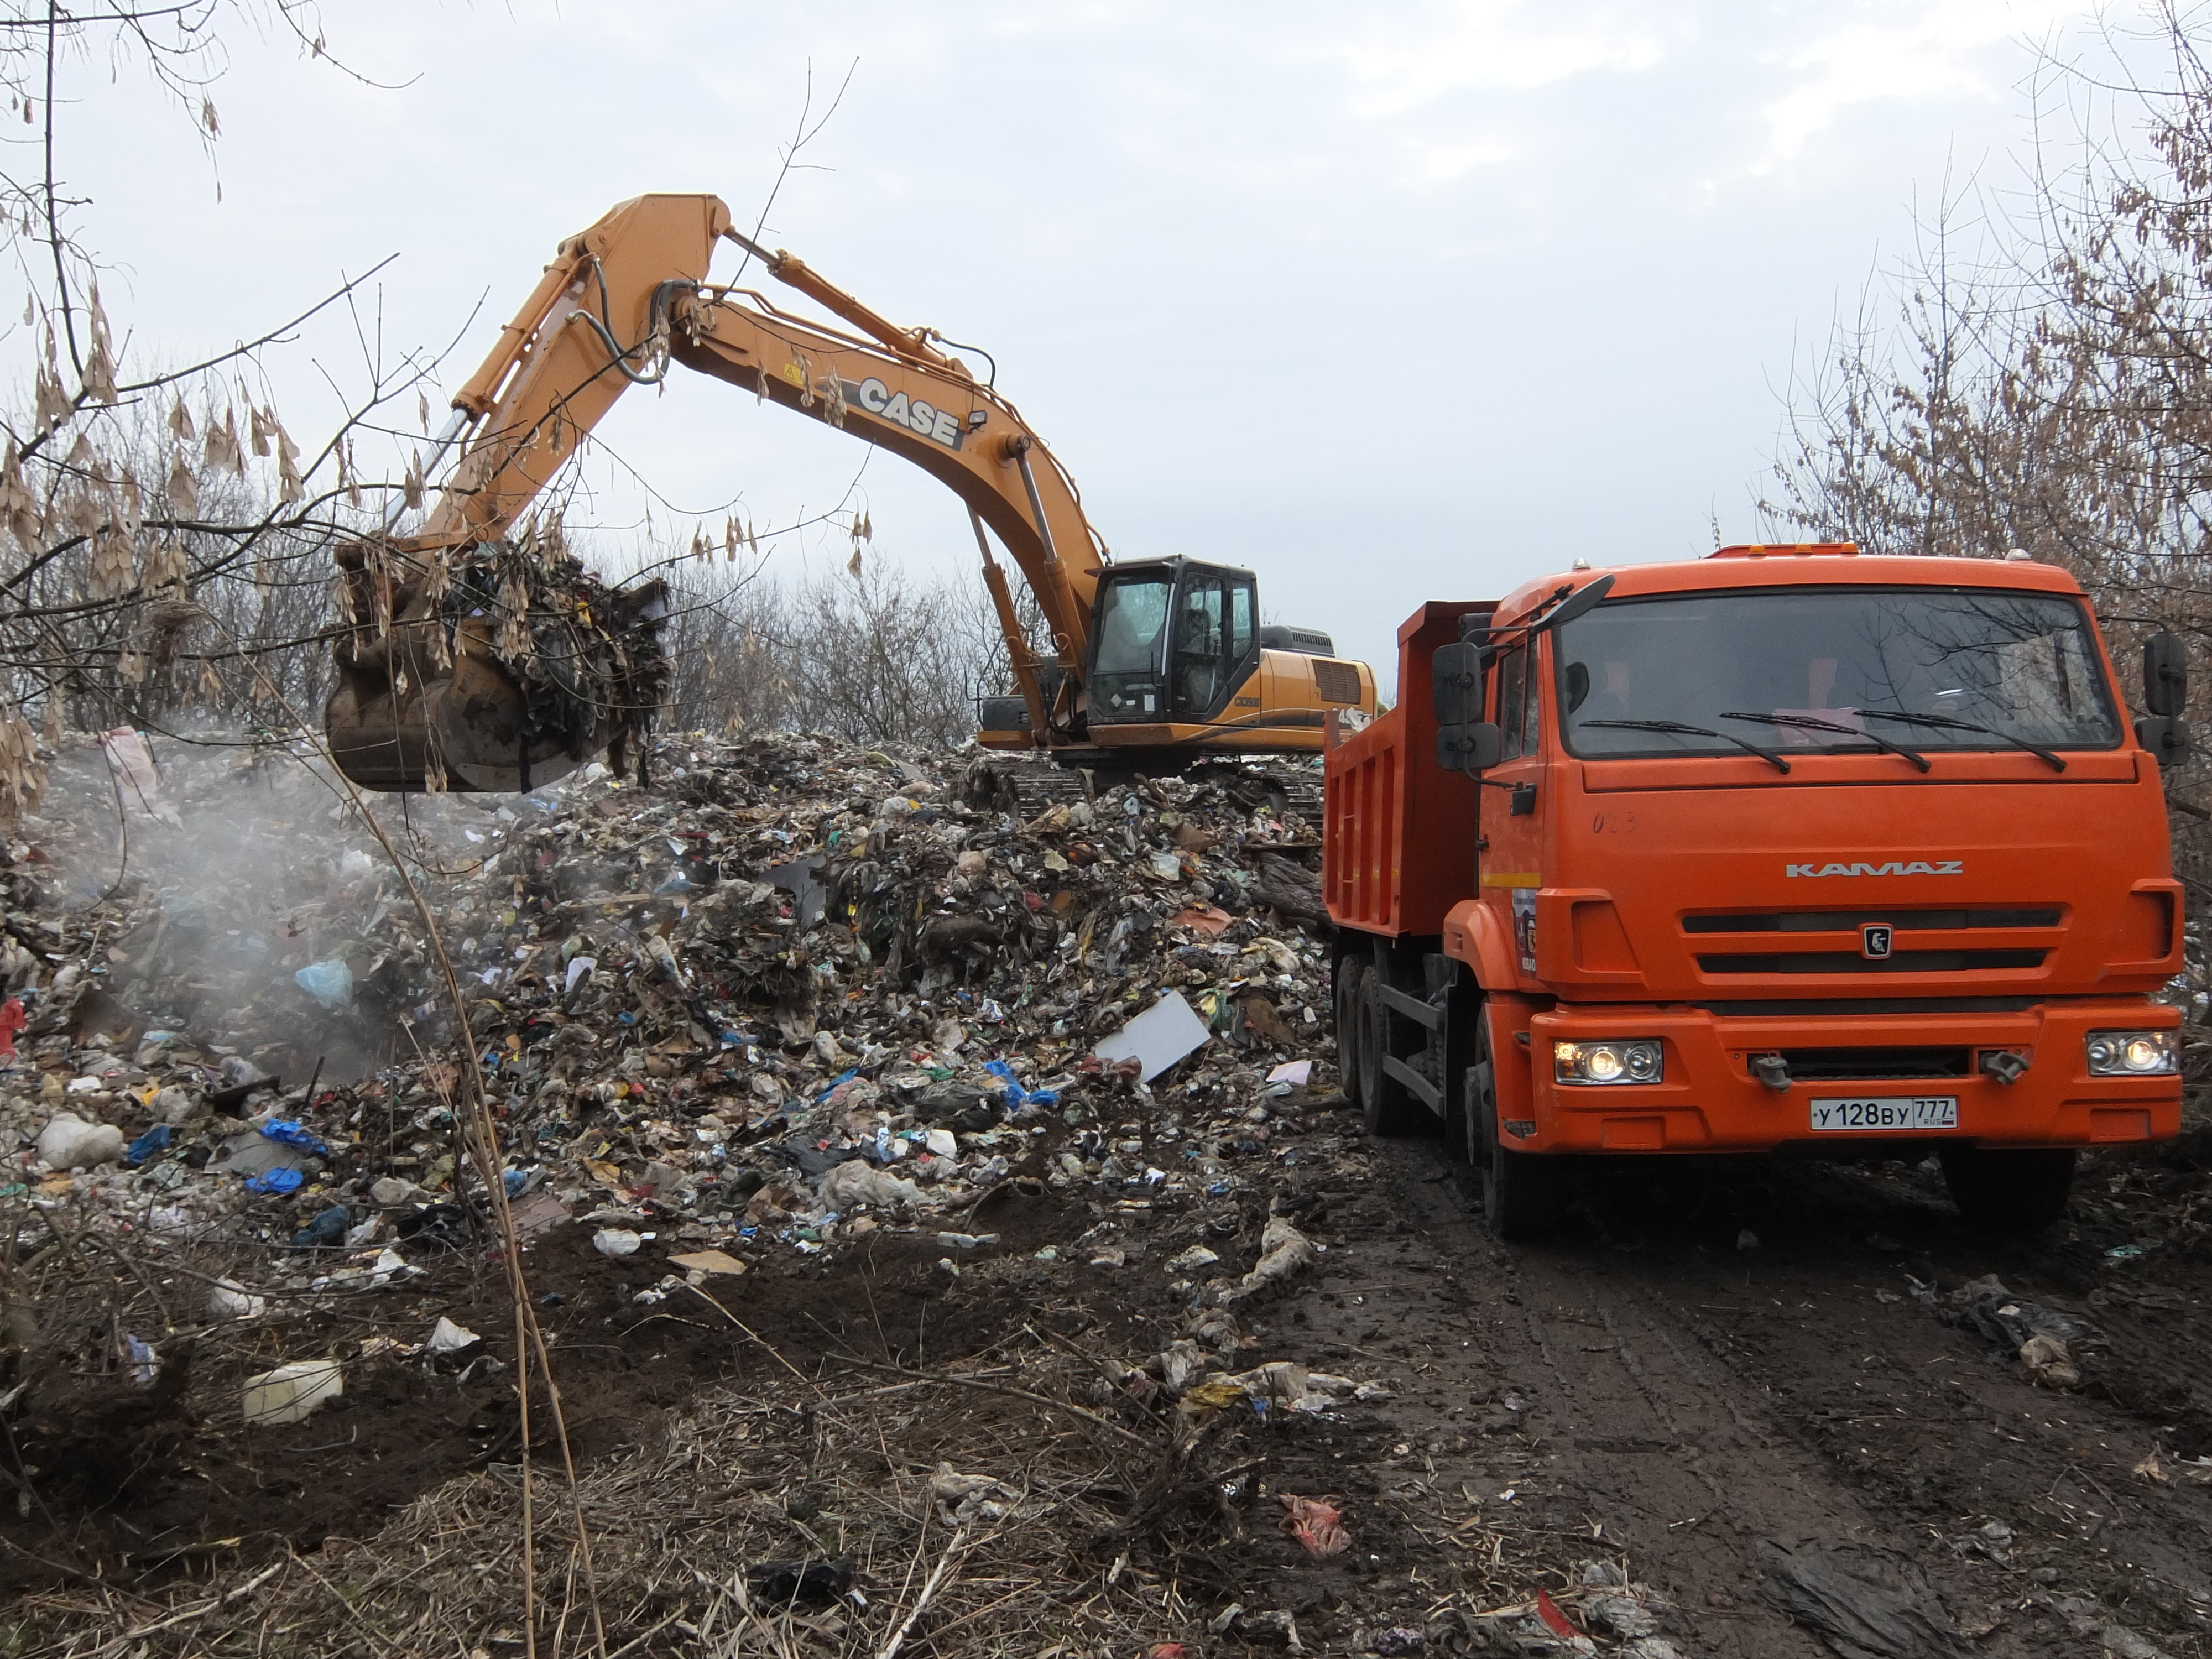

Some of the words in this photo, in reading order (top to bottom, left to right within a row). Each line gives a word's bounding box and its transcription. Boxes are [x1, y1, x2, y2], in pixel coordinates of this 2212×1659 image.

[859, 378, 959, 446] CASE
[1786, 860, 1963, 877] KAMAZ
[1914, 1100, 1949, 1118] 777
